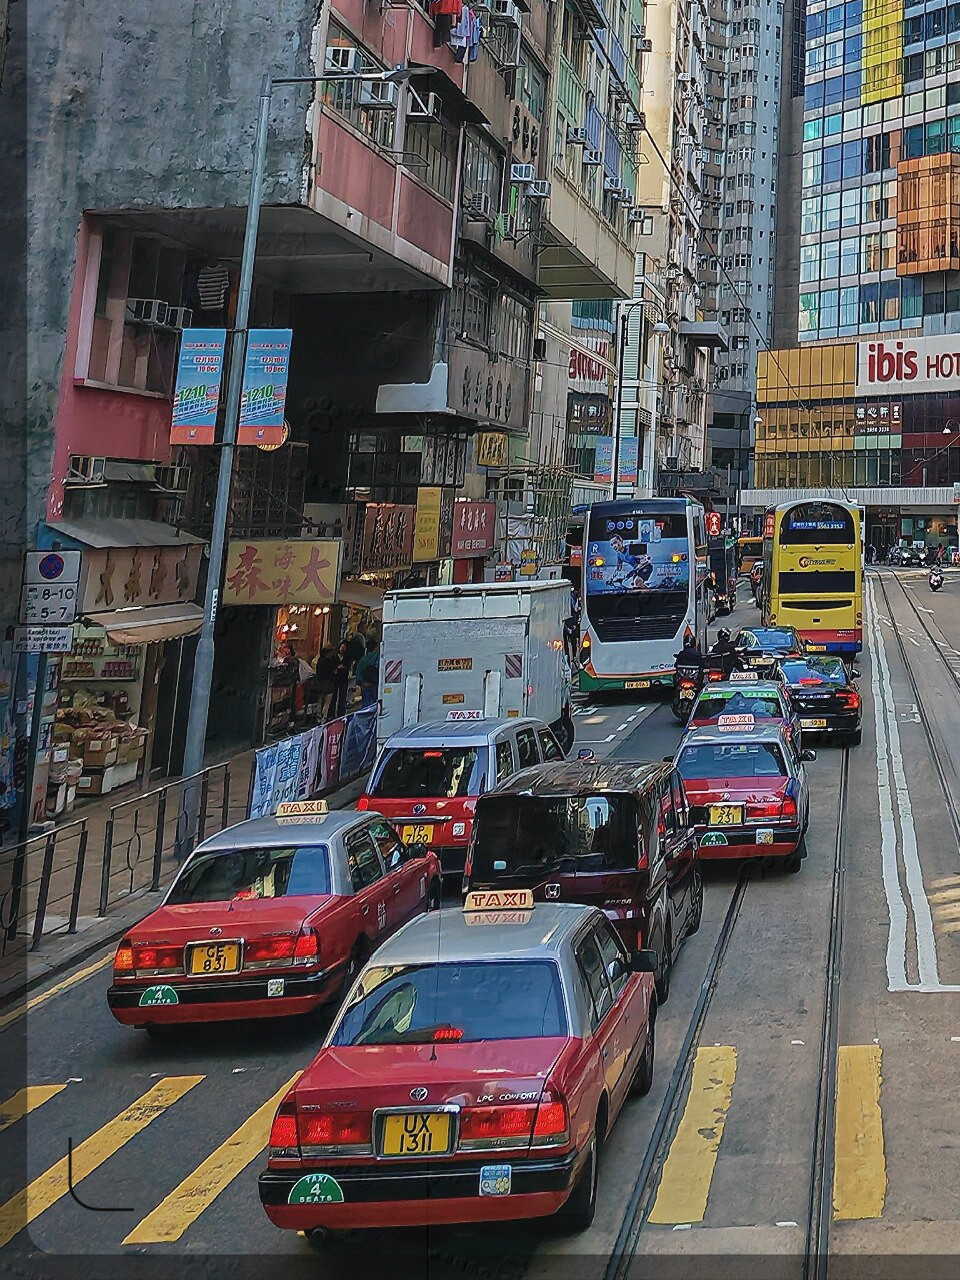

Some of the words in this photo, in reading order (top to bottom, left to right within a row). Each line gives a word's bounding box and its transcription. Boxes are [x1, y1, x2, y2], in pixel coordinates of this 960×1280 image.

[868, 341, 918, 383] ibis
[41, 588, 74, 601] 8-10
[41, 606, 68, 619] 5-7
[450, 711, 481, 719] TAXI
[722, 715, 753, 723] TAXI
[281, 801, 323, 813] TAXI
[413, 825, 425, 834] YP
[406, 833, 429, 843] 7120
[472, 893, 527, 907] TAXI
[207, 946, 225, 958] GE
[202, 956, 226, 971] 831
[155, 991, 163, 999] 4
[498, 1091, 537, 1101] COMFORT
[403, 1114, 431, 1133] UX
[399, 1132, 433, 1153] 1311
[311, 1183, 321, 1195] 4
[299, 1195, 333, 1203] SEATS
